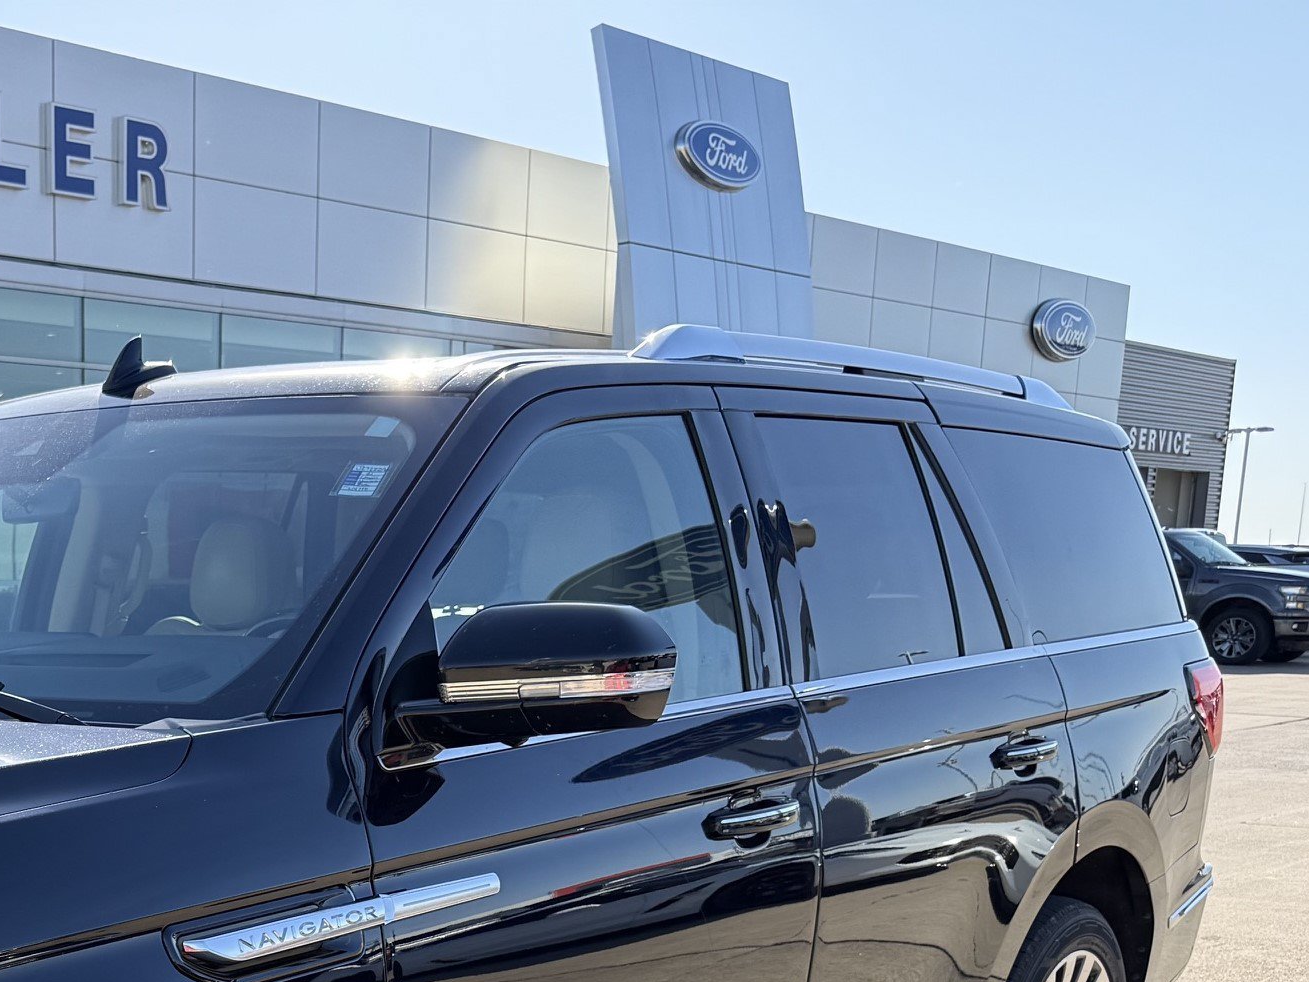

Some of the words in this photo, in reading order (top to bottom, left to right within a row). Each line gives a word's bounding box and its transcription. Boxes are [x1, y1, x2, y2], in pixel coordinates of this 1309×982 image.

[705, 132, 749, 175] Ford
[1055, 311, 1089, 348] Ford
[1129, 426, 1192, 456] SERVICE
[235, 904, 381, 953] NAVIGATOR
